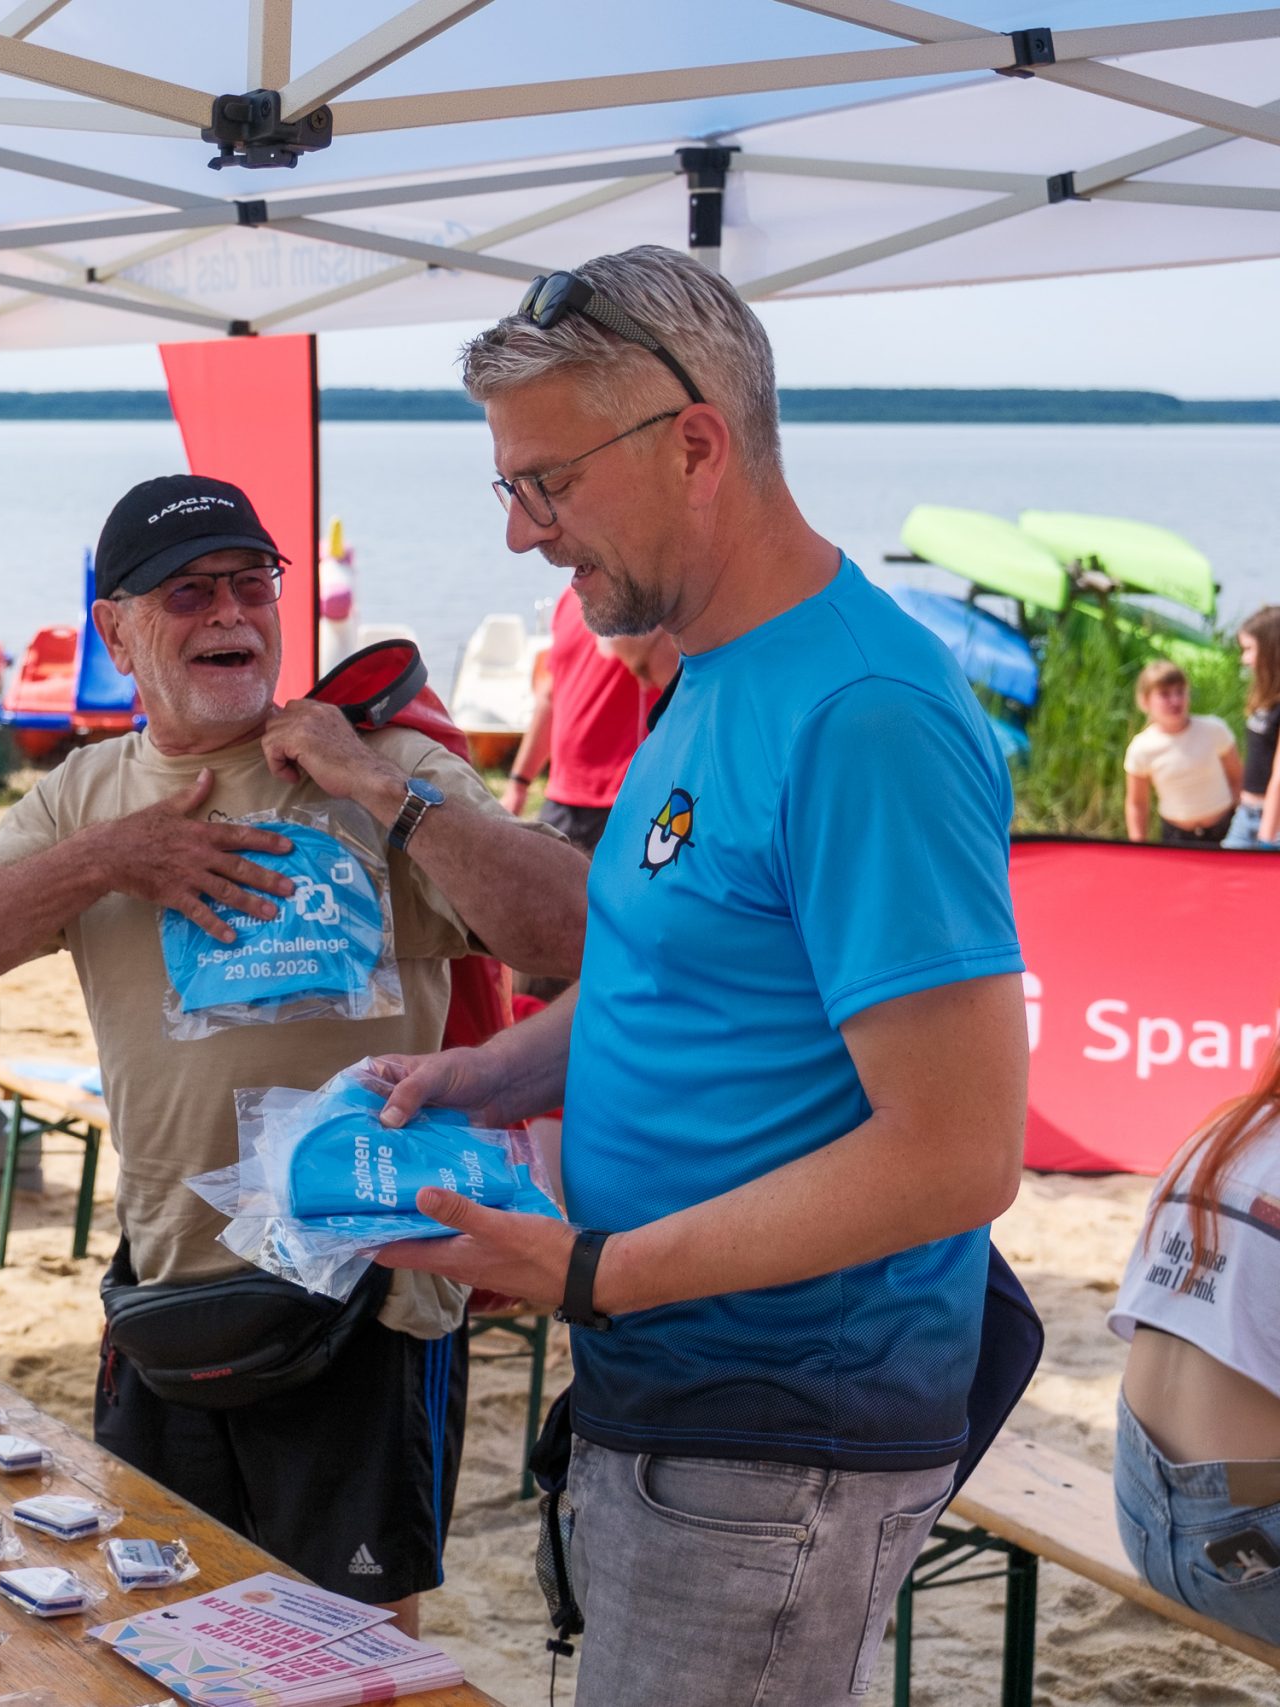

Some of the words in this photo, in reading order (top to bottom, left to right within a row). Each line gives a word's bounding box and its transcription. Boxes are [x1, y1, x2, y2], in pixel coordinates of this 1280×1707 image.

[179, 505, 210, 515] TEAM
[224, 959, 318, 981] 29.06.2026
[1082, 999, 1280, 1080] Spar
[355, 1136, 375, 1202] Sachsen
[373, 1145, 397, 1207] Energie
[438, 1168, 457, 1192] asse
[1146, 1263, 1173, 1287] hen
